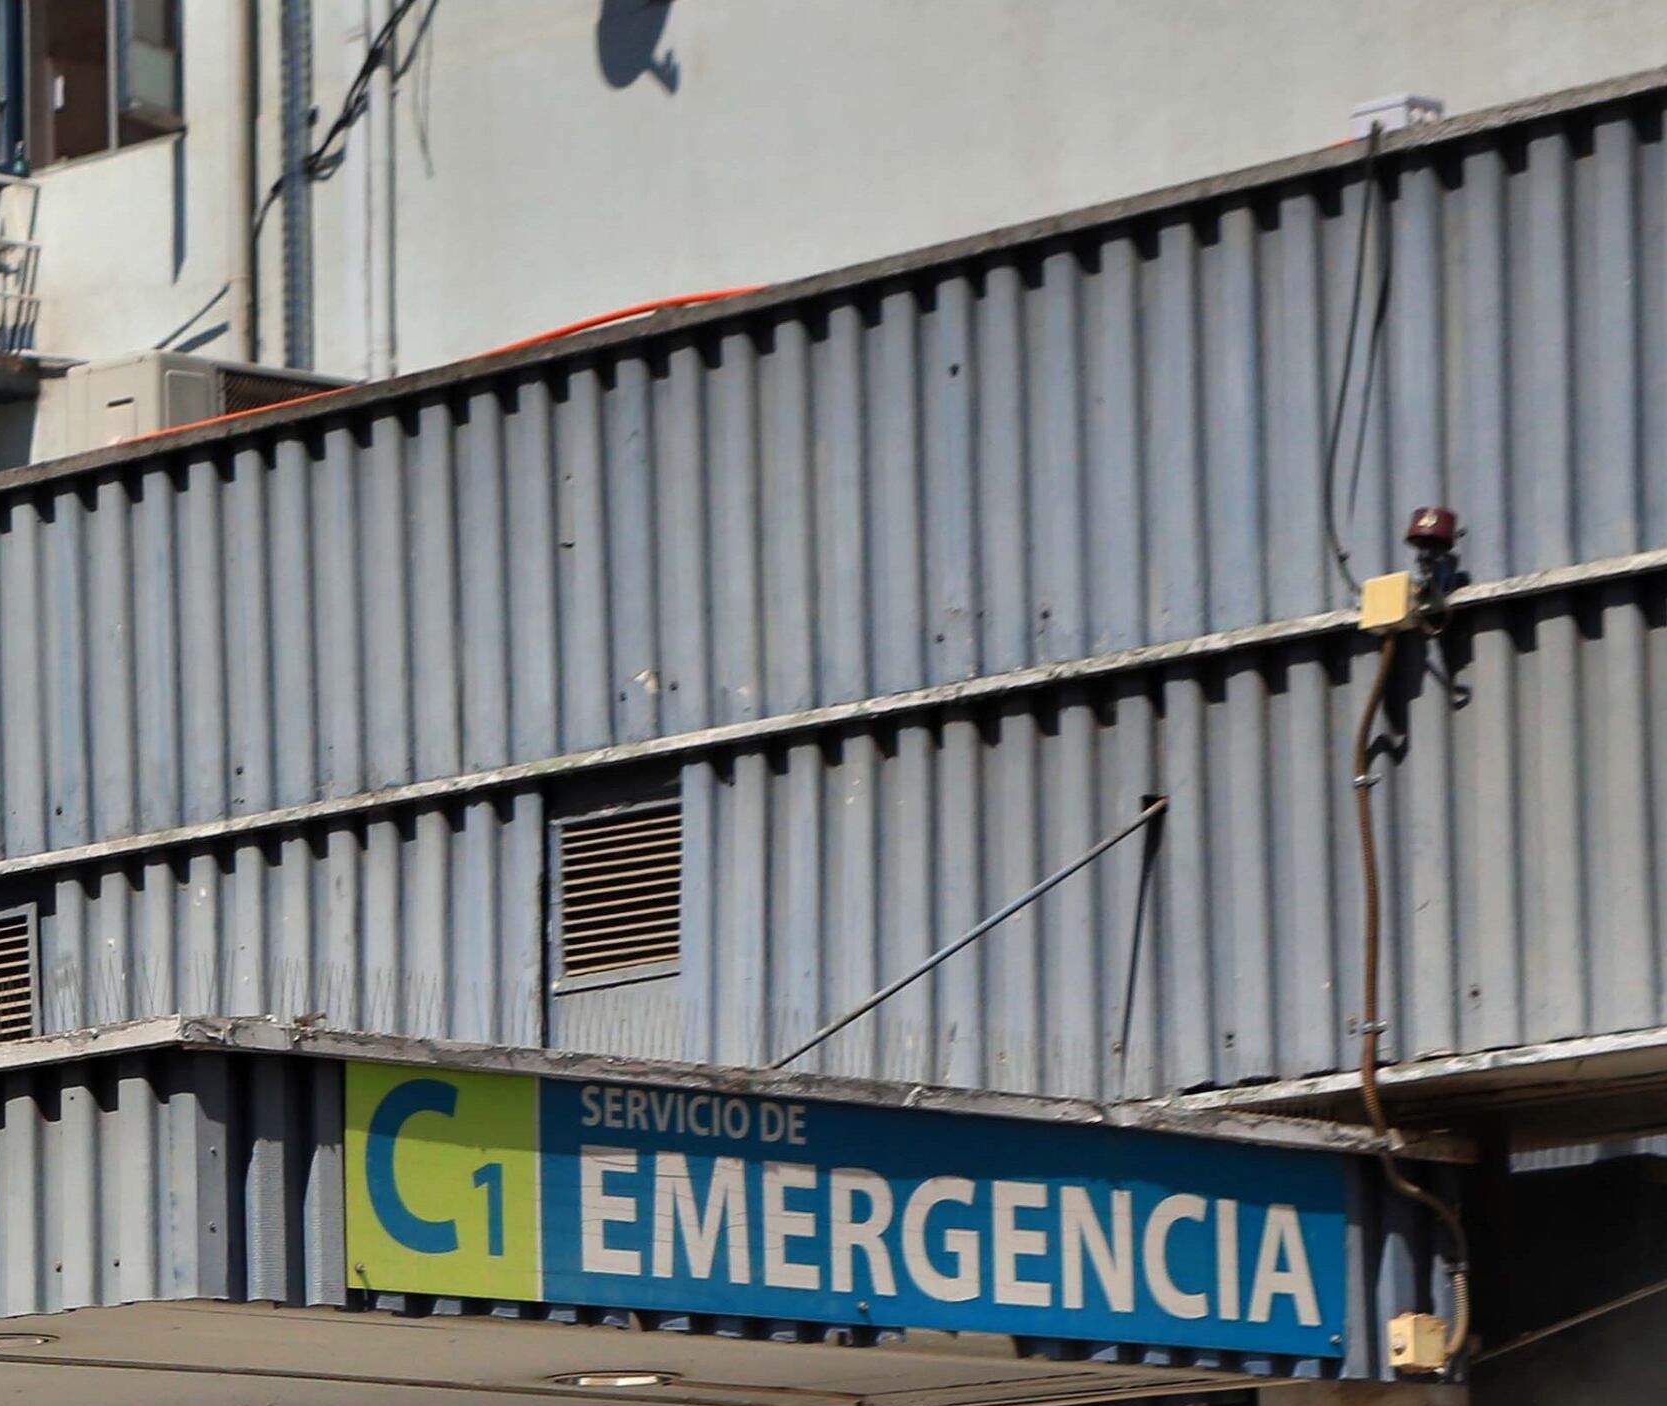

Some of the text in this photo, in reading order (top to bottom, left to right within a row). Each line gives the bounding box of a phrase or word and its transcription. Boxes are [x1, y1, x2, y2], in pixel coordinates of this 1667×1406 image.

[364, 1079, 505, 1257] C1
[580, 1084, 807, 1146] SERVICIO DE
[579, 1144, 1322, 1328] EMERGENCIA
